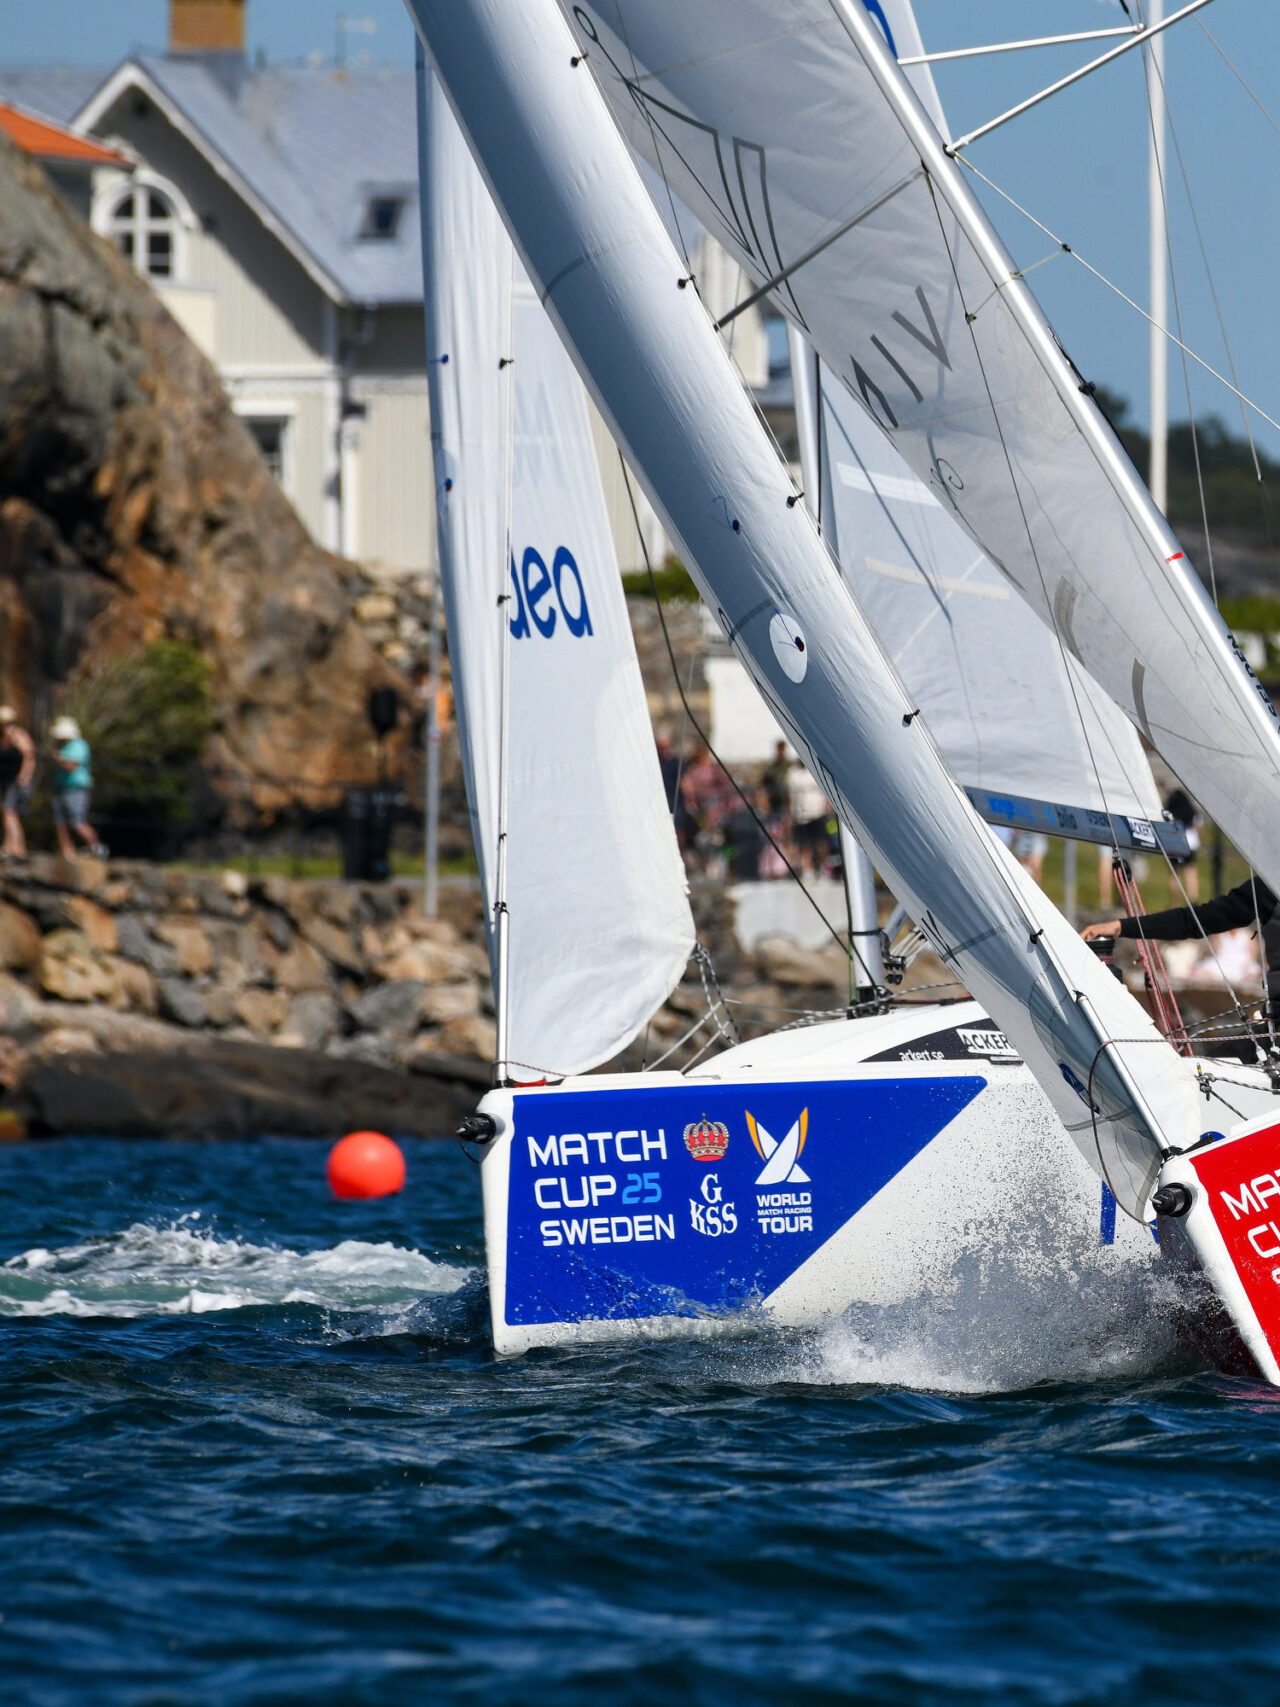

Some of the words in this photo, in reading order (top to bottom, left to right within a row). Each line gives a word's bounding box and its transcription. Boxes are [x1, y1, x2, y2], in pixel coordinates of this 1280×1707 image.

[899, 1050, 944, 1061] ackert.se
[528, 1129, 667, 1167] MATCH
[535, 1175, 616, 1210] CUP
[621, 1172, 662, 1204] 25
[700, 1173, 722, 1204] G
[756, 1192, 812, 1207] WORLD
[689, 1198, 738, 1237] KSS
[757, 1208, 783, 1216] MATCH
[784, 1207, 812, 1215] RACING
[757, 1215, 813, 1234] TOUR
[540, 1214, 675, 1247] SWEDEN
